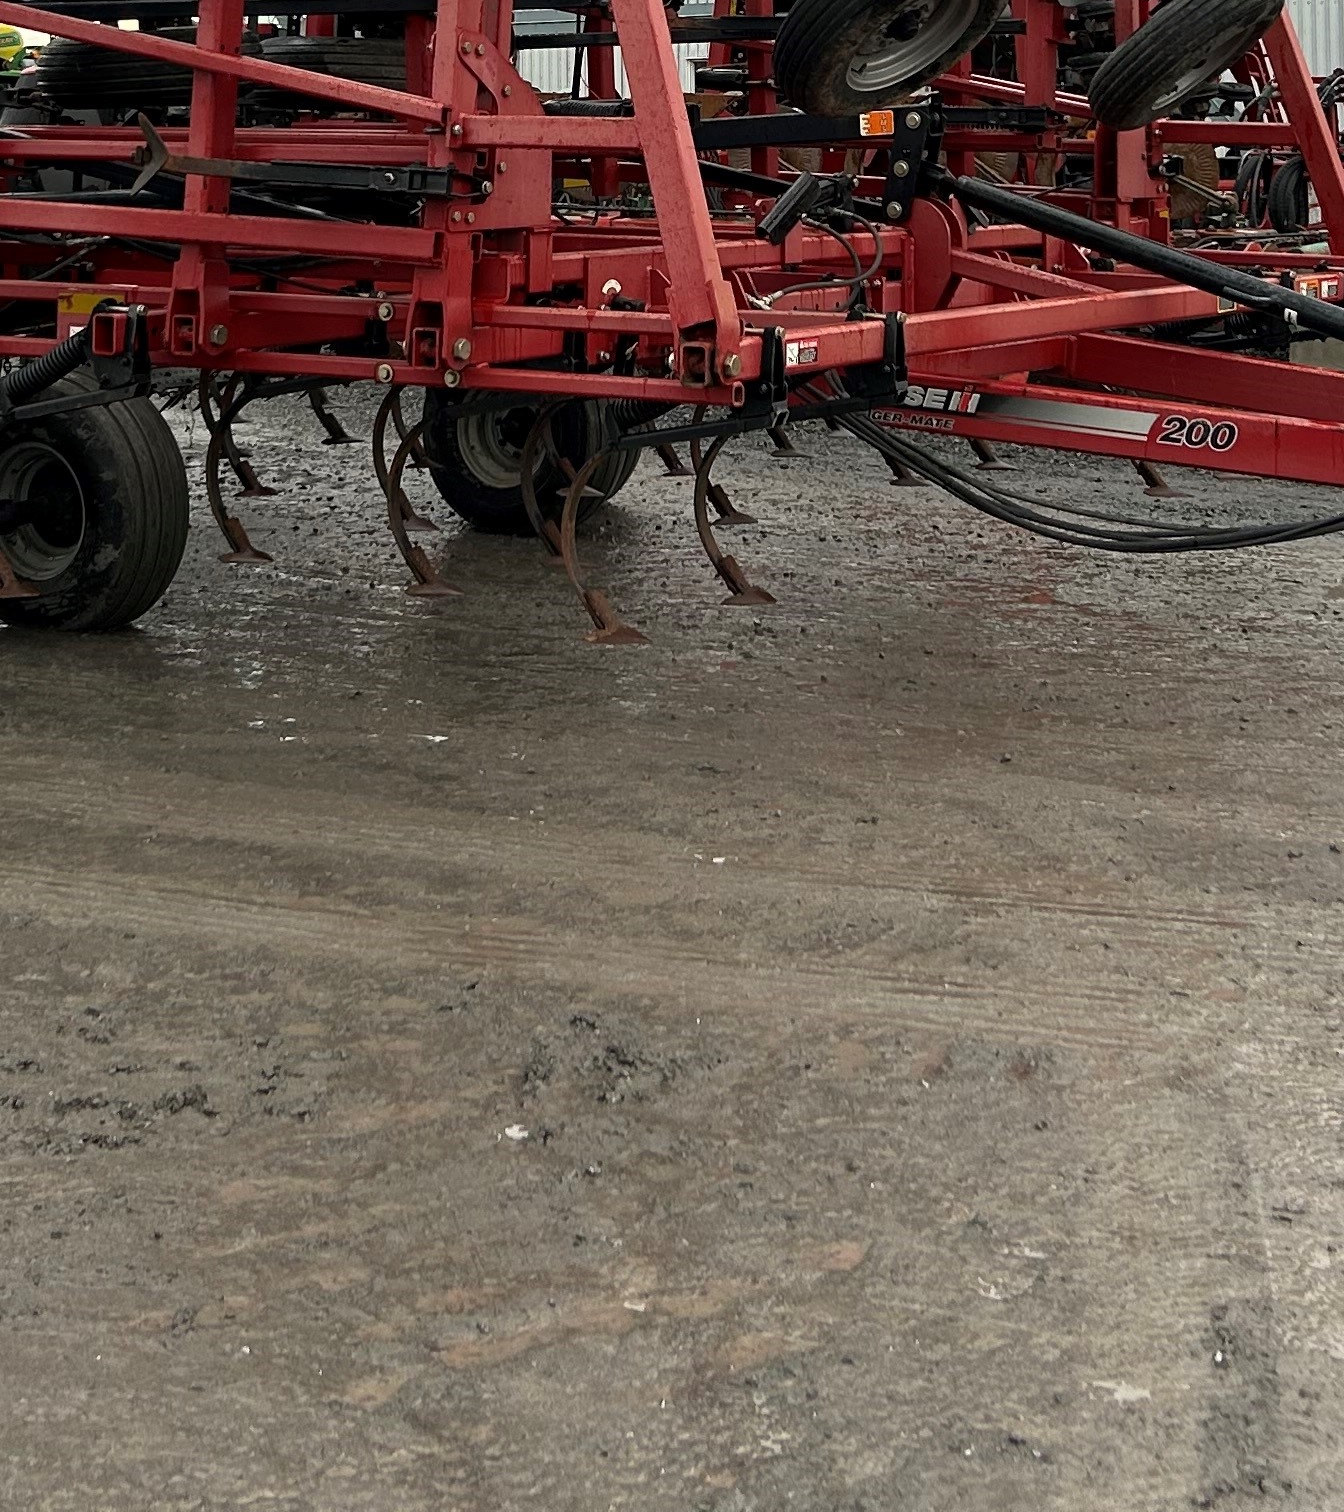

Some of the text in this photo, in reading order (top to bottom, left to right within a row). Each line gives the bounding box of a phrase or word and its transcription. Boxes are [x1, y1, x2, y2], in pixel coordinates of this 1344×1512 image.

[903, 385, 949, 410] SE
[871, 410, 955, 431] GER-MATE
[1156, 414, 1239, 452] 200
